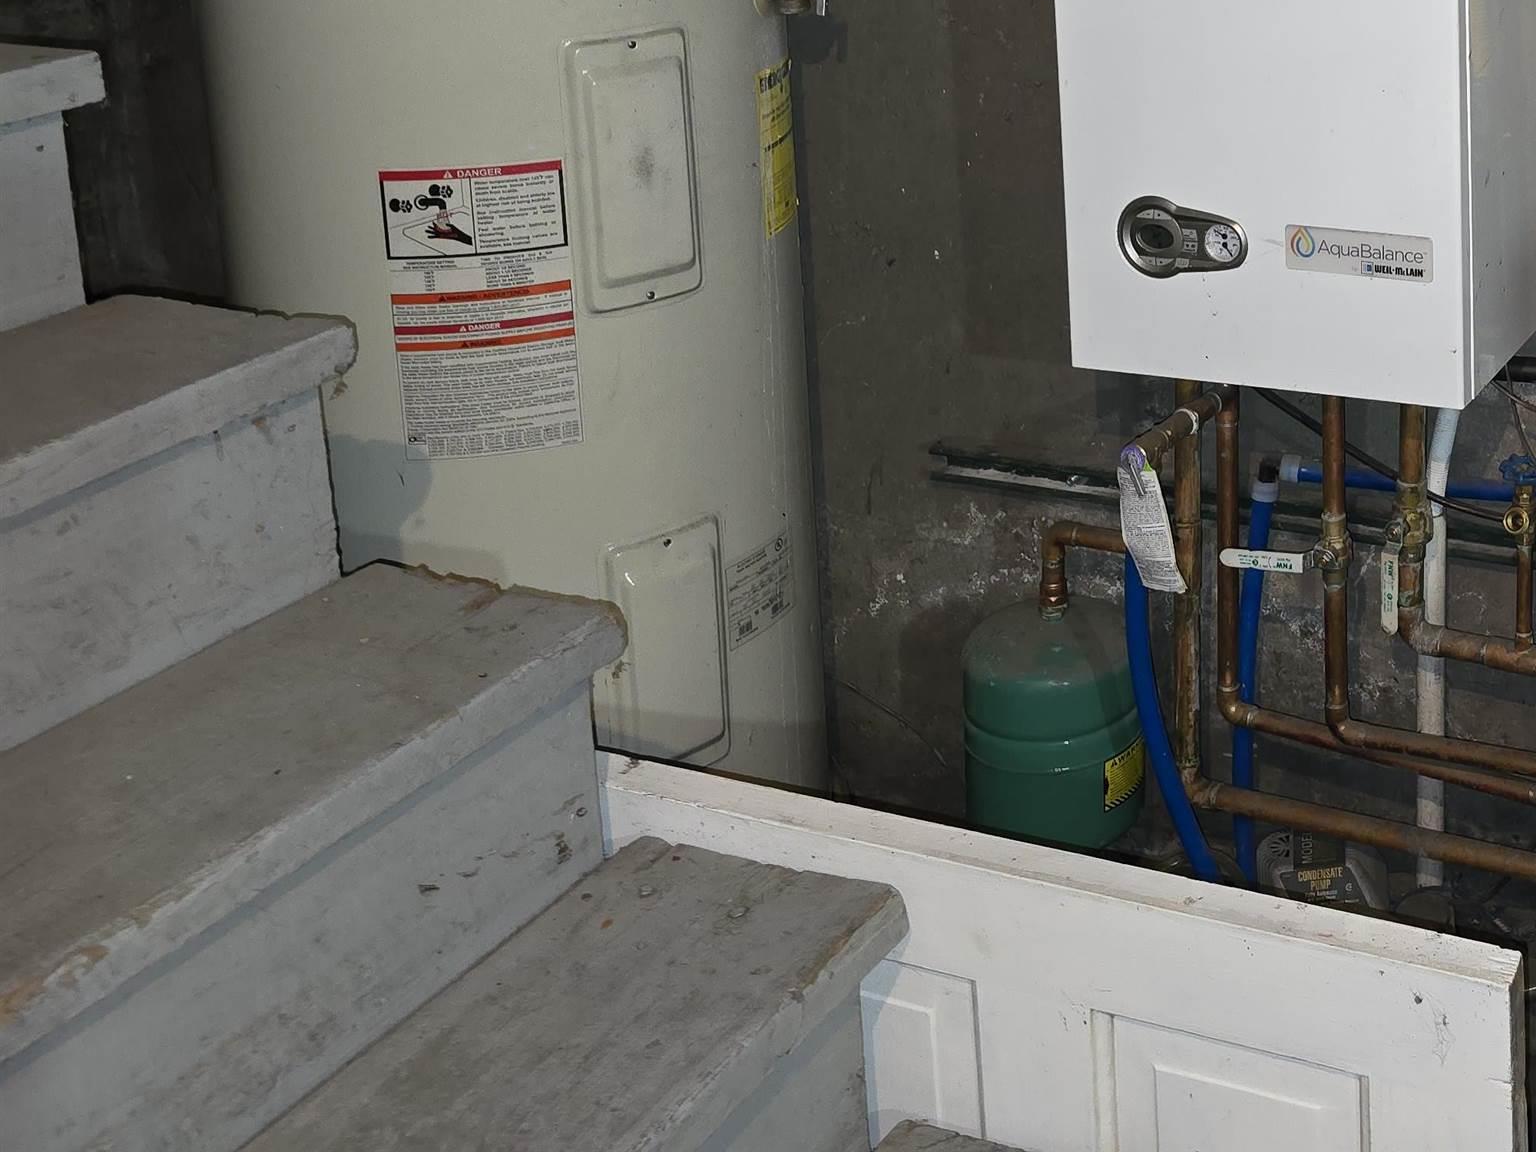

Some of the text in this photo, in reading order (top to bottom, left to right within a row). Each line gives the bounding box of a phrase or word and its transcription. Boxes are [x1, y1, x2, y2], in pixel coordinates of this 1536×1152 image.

[456, 167, 502, 178] DANGER
[1317, 239, 1424, 264] AquaBalance
[468, 322, 501, 332] DANGER
[1276, 562, 1293, 570] FNW
[1297, 866, 1344, 882] CONDENSATE
[1310, 878, 1332, 891] PUMP
